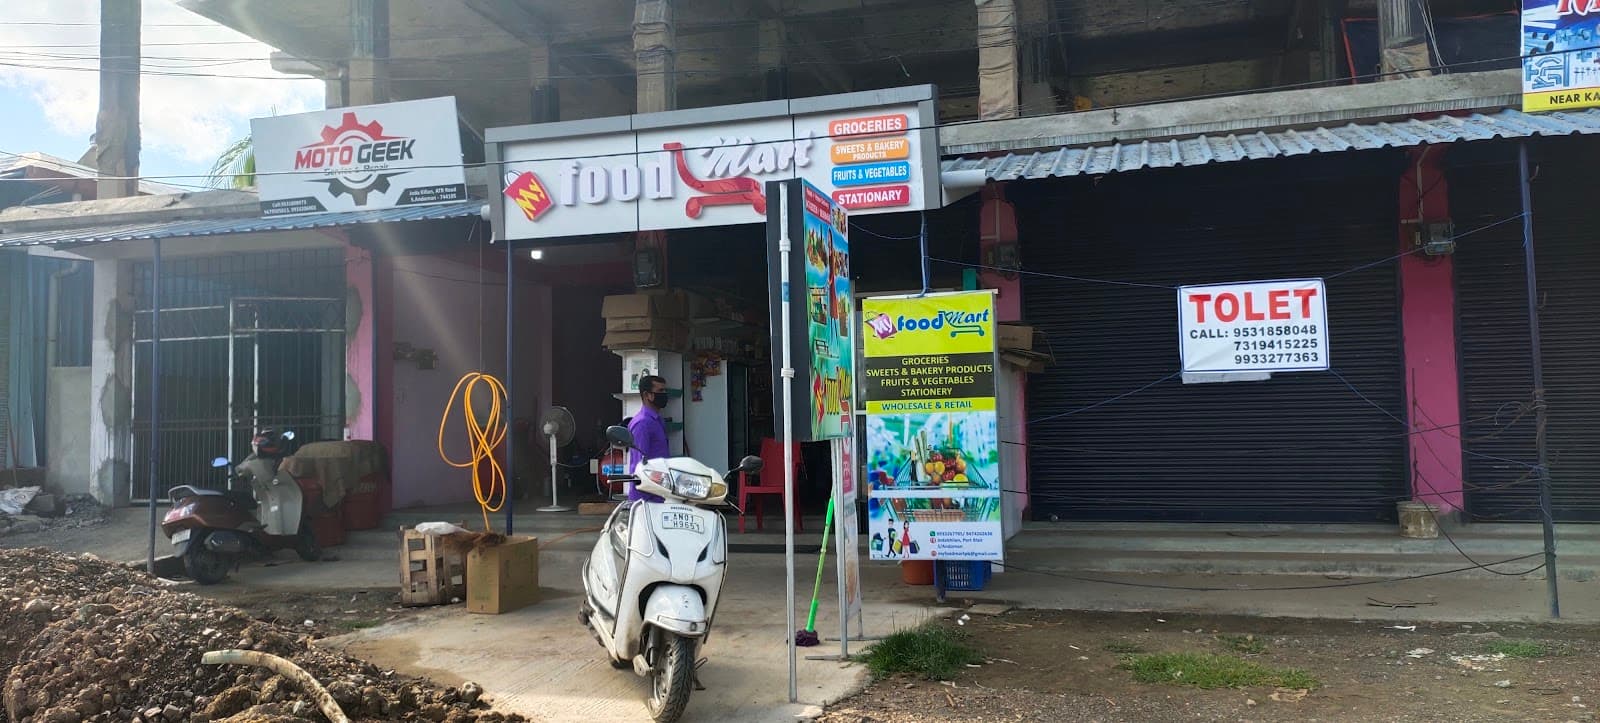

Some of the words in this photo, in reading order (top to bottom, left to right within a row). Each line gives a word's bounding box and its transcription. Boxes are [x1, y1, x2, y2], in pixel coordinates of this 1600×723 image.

[1550, 93, 1580, 104] NEAR
[834, 117, 902, 135] GROCERIES
[836, 143, 864, 154] SWEETS
[865, 142, 873, 152] &
[874, 140, 905, 152] BAKERY
[294, 145, 353, 170] MOTO
[357, 139, 416, 164] GEEK
[852, 151, 887, 160] PRODUCTS
[560, 150, 676, 206] food
[701, 127, 816, 178] Mart
[834, 169, 857, 181] FRUITS
[857, 169, 864, 179] &
[864, 165, 907, 179] VEGETABLES
[838, 190, 902, 205] STATIONARY
[1188, 288, 1318, 323] TOLET
[897, 313, 944, 331] food
[1189, 328, 1229, 339] CALL:
[1233, 324, 1317, 337] 9531858048
[1234, 338, 1318, 351] 7319415225
[901, 356, 949, 366] GROCERIES
[1234, 352, 1319, 364] 9933277363
[866, 368, 899, 377] SWEETS
[901, 367, 908, 376] &
[910, 366, 943, 375] BAKERY
[946, 364, 992, 374] PRODUCTS
[881, 378, 910, 387] FRUITS
[912, 377, 919, 386] &
[921, 376, 974, 385] VEGETABLES
[901, 387, 953, 397] STATIONERY
[882, 402, 932, 411] WHOLESALE
[935, 401, 941, 409] &
[944, 401, 972, 409] RETAIL
